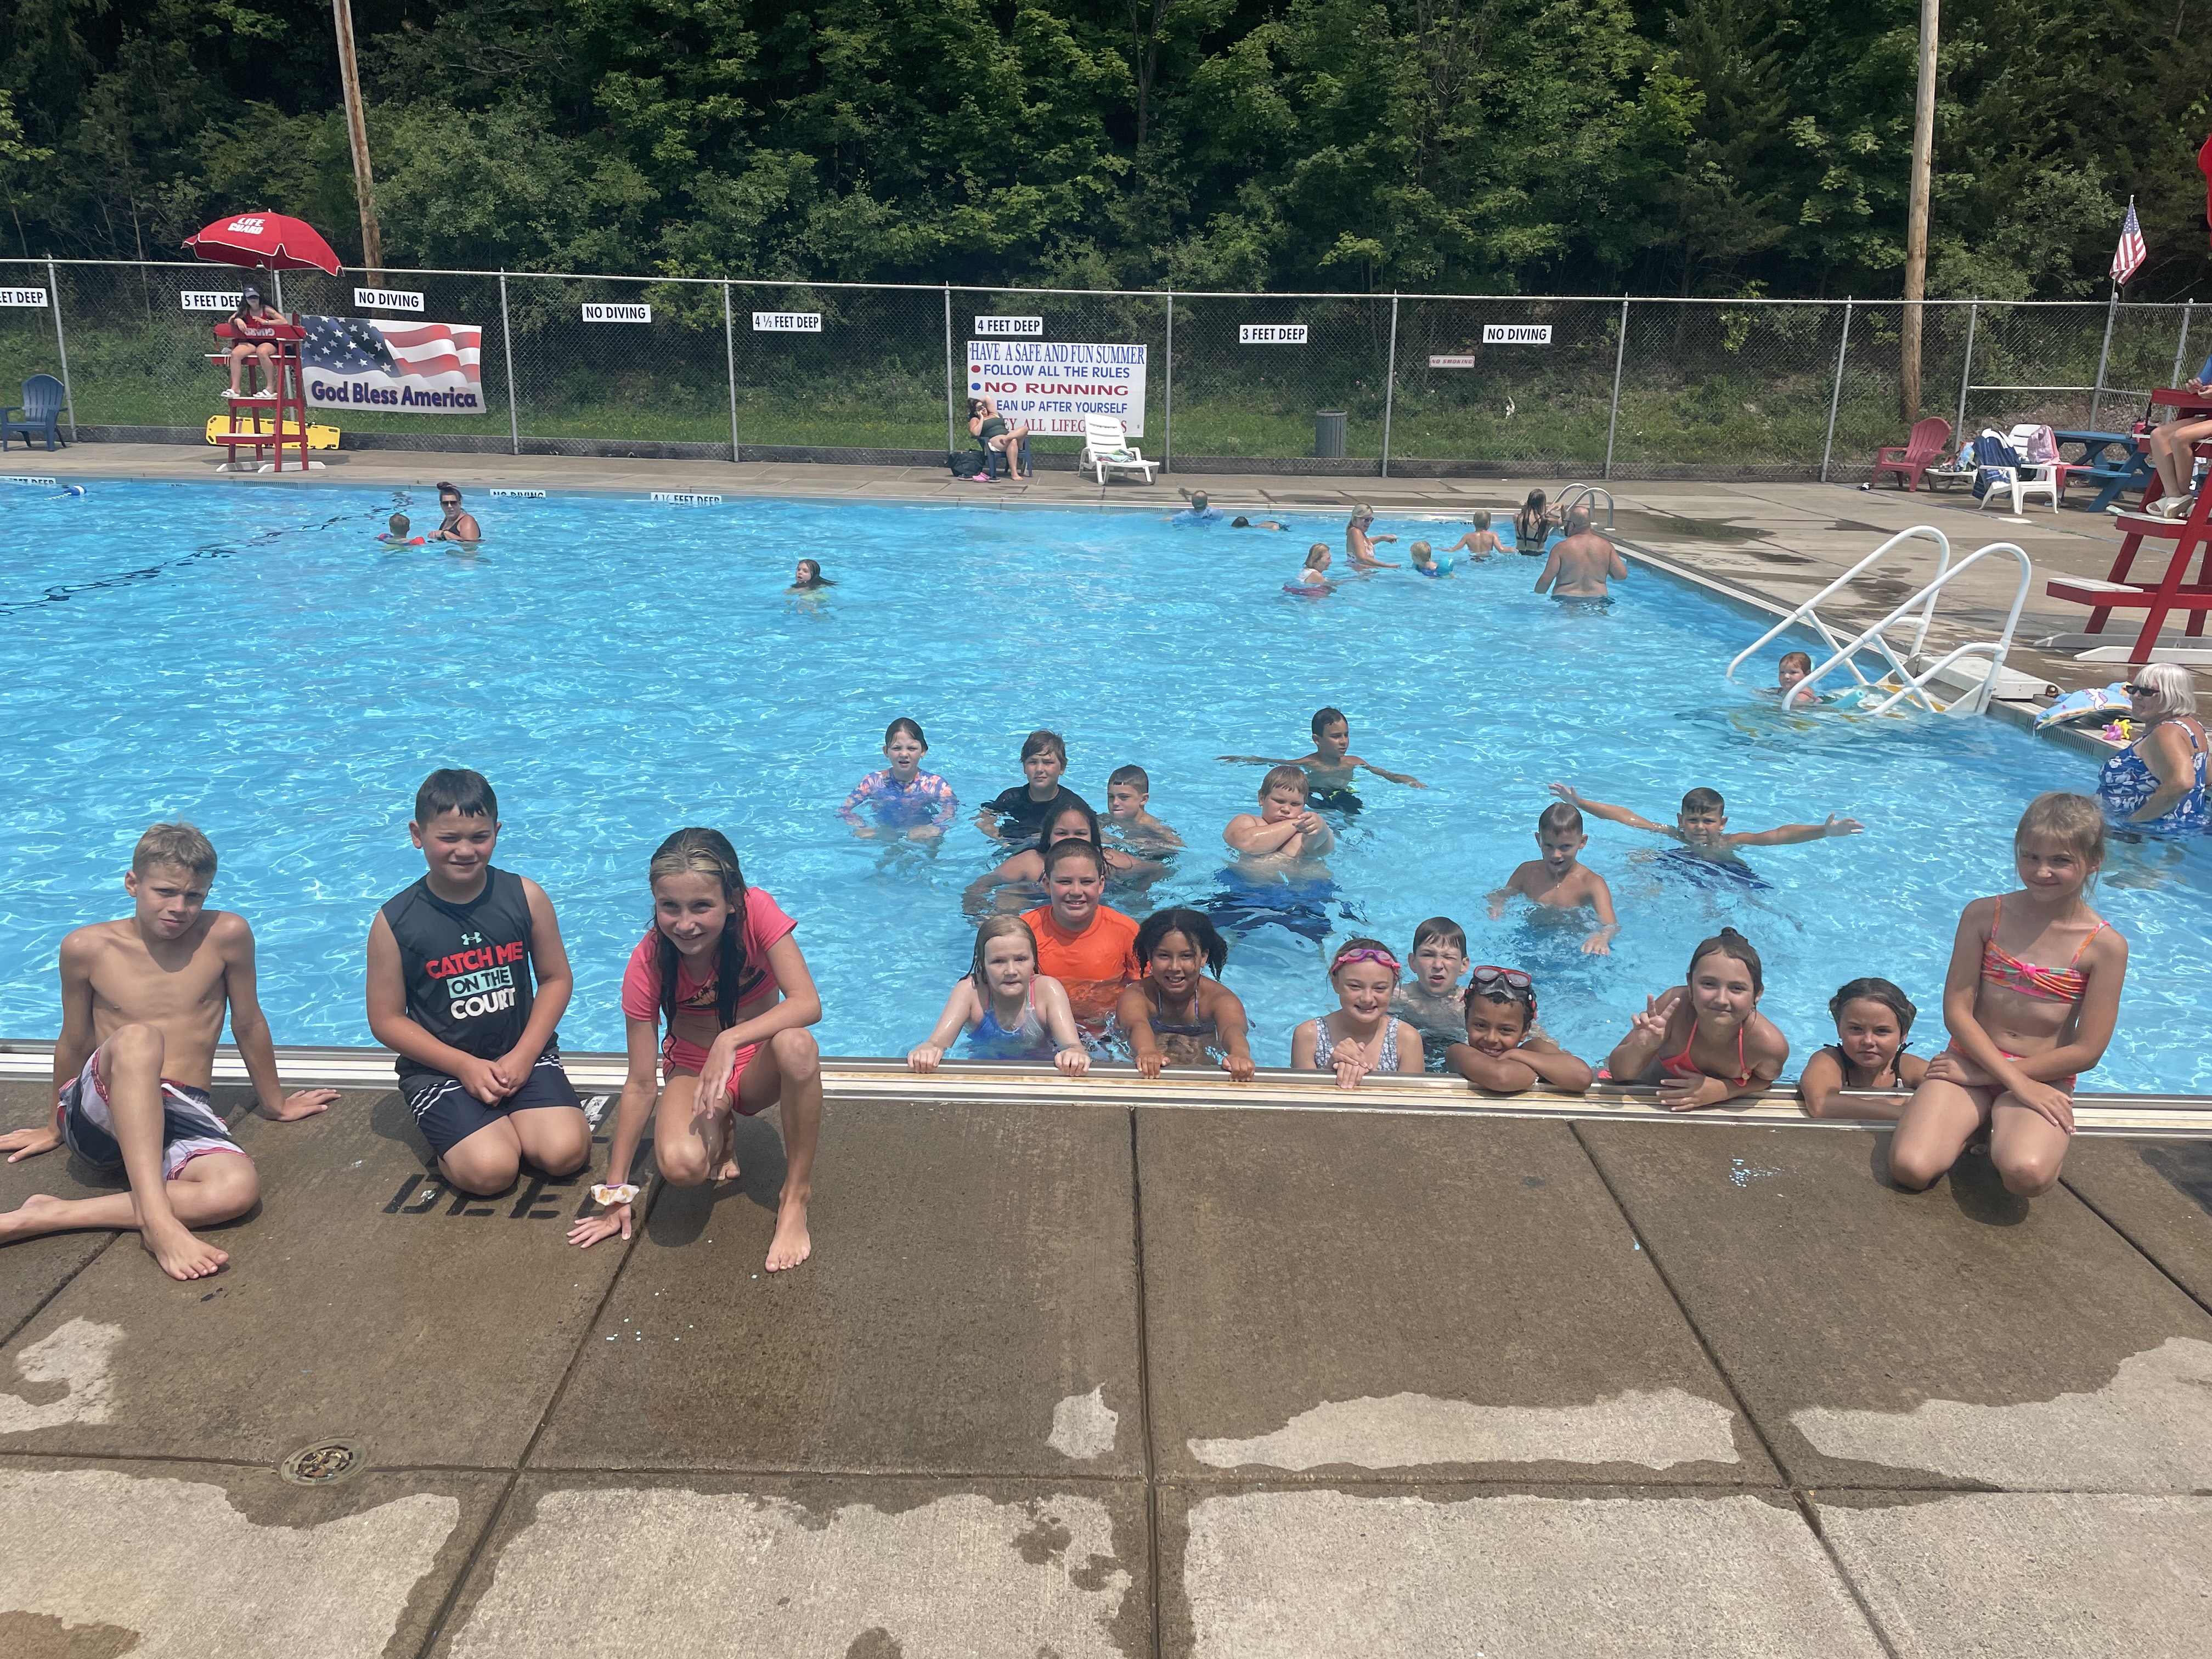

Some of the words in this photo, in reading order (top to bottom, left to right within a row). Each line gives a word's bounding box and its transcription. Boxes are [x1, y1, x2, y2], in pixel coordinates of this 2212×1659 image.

[227, 222, 264, 235] GUARD
[238, 217, 266, 227] LIFE
[16, 291, 43, 303] DEEP
[184, 295, 190, 307] 5
[194, 295, 217, 307] FEET
[221, 295, 241, 307] DEE
[359, 291, 375, 304] NO
[379, 293, 419, 307] DIVING
[586, 306, 602, 318] NO
[606, 307, 646, 319] DIVING
[755, 315, 760, 328] 4
[775, 316, 794, 328] FEET
[797, 316, 819, 328] DEEP
[978, 320, 984, 331] 4
[988, 320, 1011, 332] FEET
[1014, 320, 1040, 332] DEEP
[1242, 328, 1249, 340] 3
[1252, 328, 1276, 340] FEET
[1279, 328, 1305, 340] DEEP
[1487, 328, 1504, 340] NO
[1508, 328, 1547, 341] DIVING
[970, 342, 1001, 360] HAVE
[1005, 343, 1013, 361] A
[1015, 343, 1042, 362] SAFE
[1044, 344, 1068, 362] AND
[1070, 345, 1094, 363] FUN
[1096, 345, 1145, 364] SUMMER
[984, 364, 1034, 376] FOLLOW
[1038, 365, 1060, 377] ALL
[1063, 366, 1088, 377] THE
[1092, 366, 1130, 378] RULES
[311, 380, 349, 402] God
[352, 382, 398, 405] Bless
[401, 385, 478, 408] America
[985, 382, 1017, 393] NO
[1025, 383, 1128, 396] RUNNING
[1022, 400, 1035, 411] UP
[1038, 401, 1072, 412] AFTER
[1075, 402, 1128, 414] YOURSELF
[1024, 418, 1046, 432] ALL
[426, 946, 494, 979] CATCH
[495, 941, 523, 965] ME
[452, 975, 480, 995] ON
[481, 969, 510, 988] THE
[450, 987, 516, 1020] COURT
